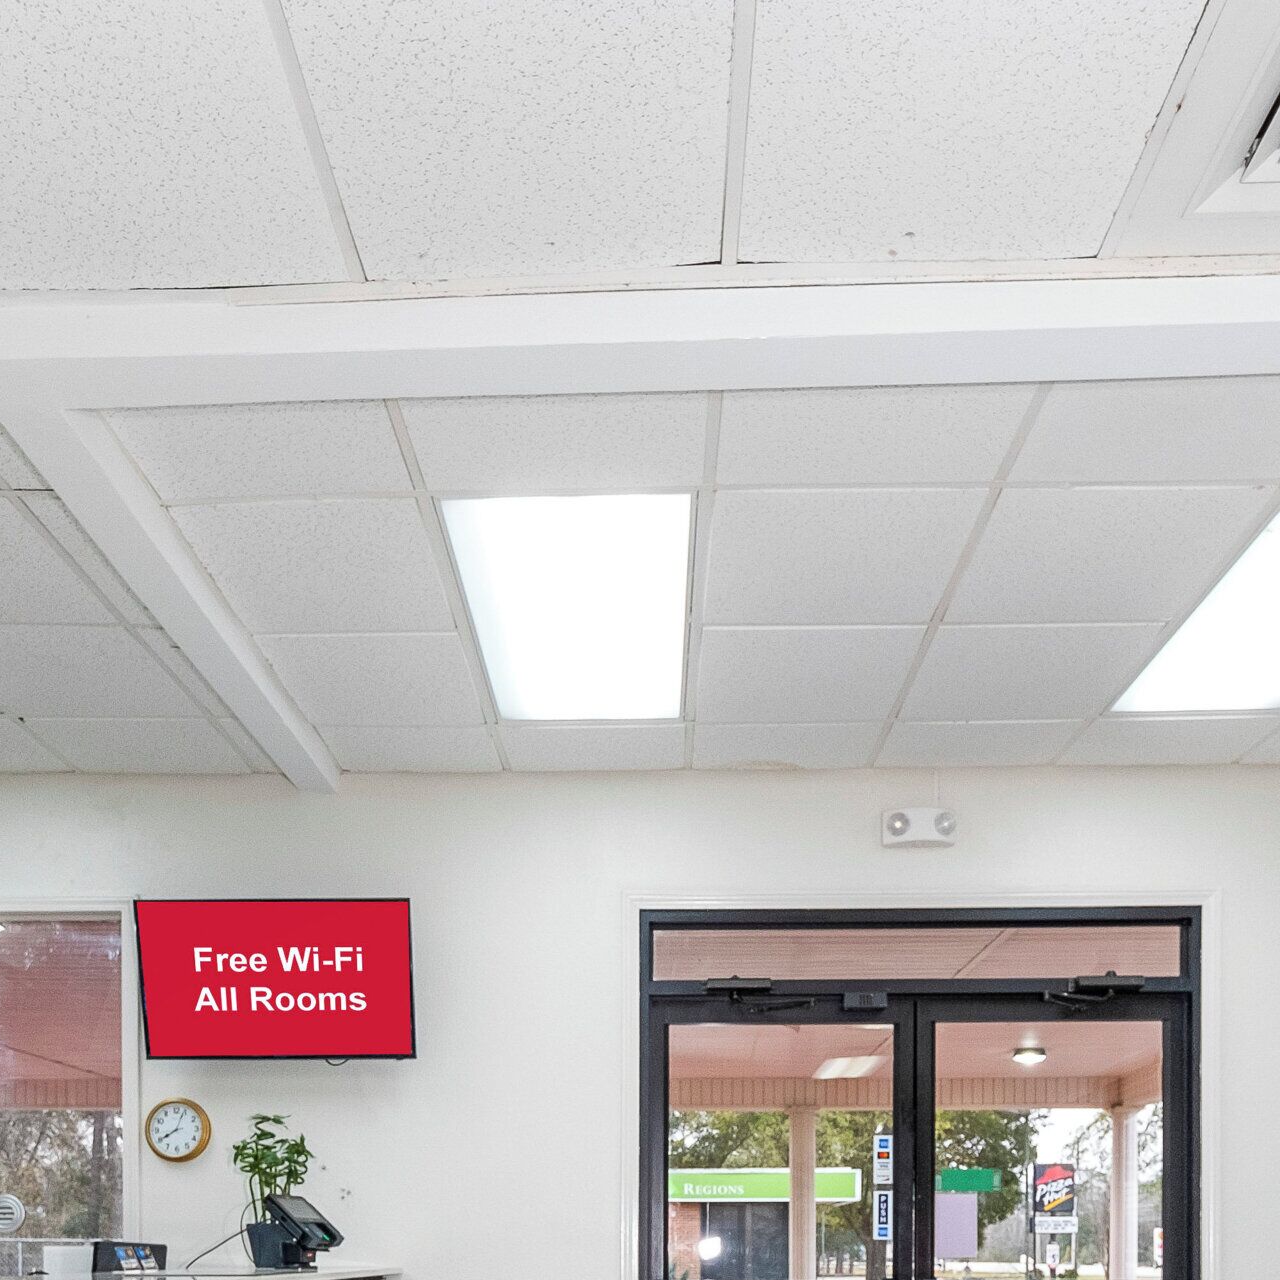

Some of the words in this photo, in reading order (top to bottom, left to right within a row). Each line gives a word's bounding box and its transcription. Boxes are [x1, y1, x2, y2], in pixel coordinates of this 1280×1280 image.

[194, 948, 268, 972] Free
[278, 947, 363, 972] Wi-Fi
[195, 987, 238, 1011] All
[250, 987, 366, 1011] Rooms
